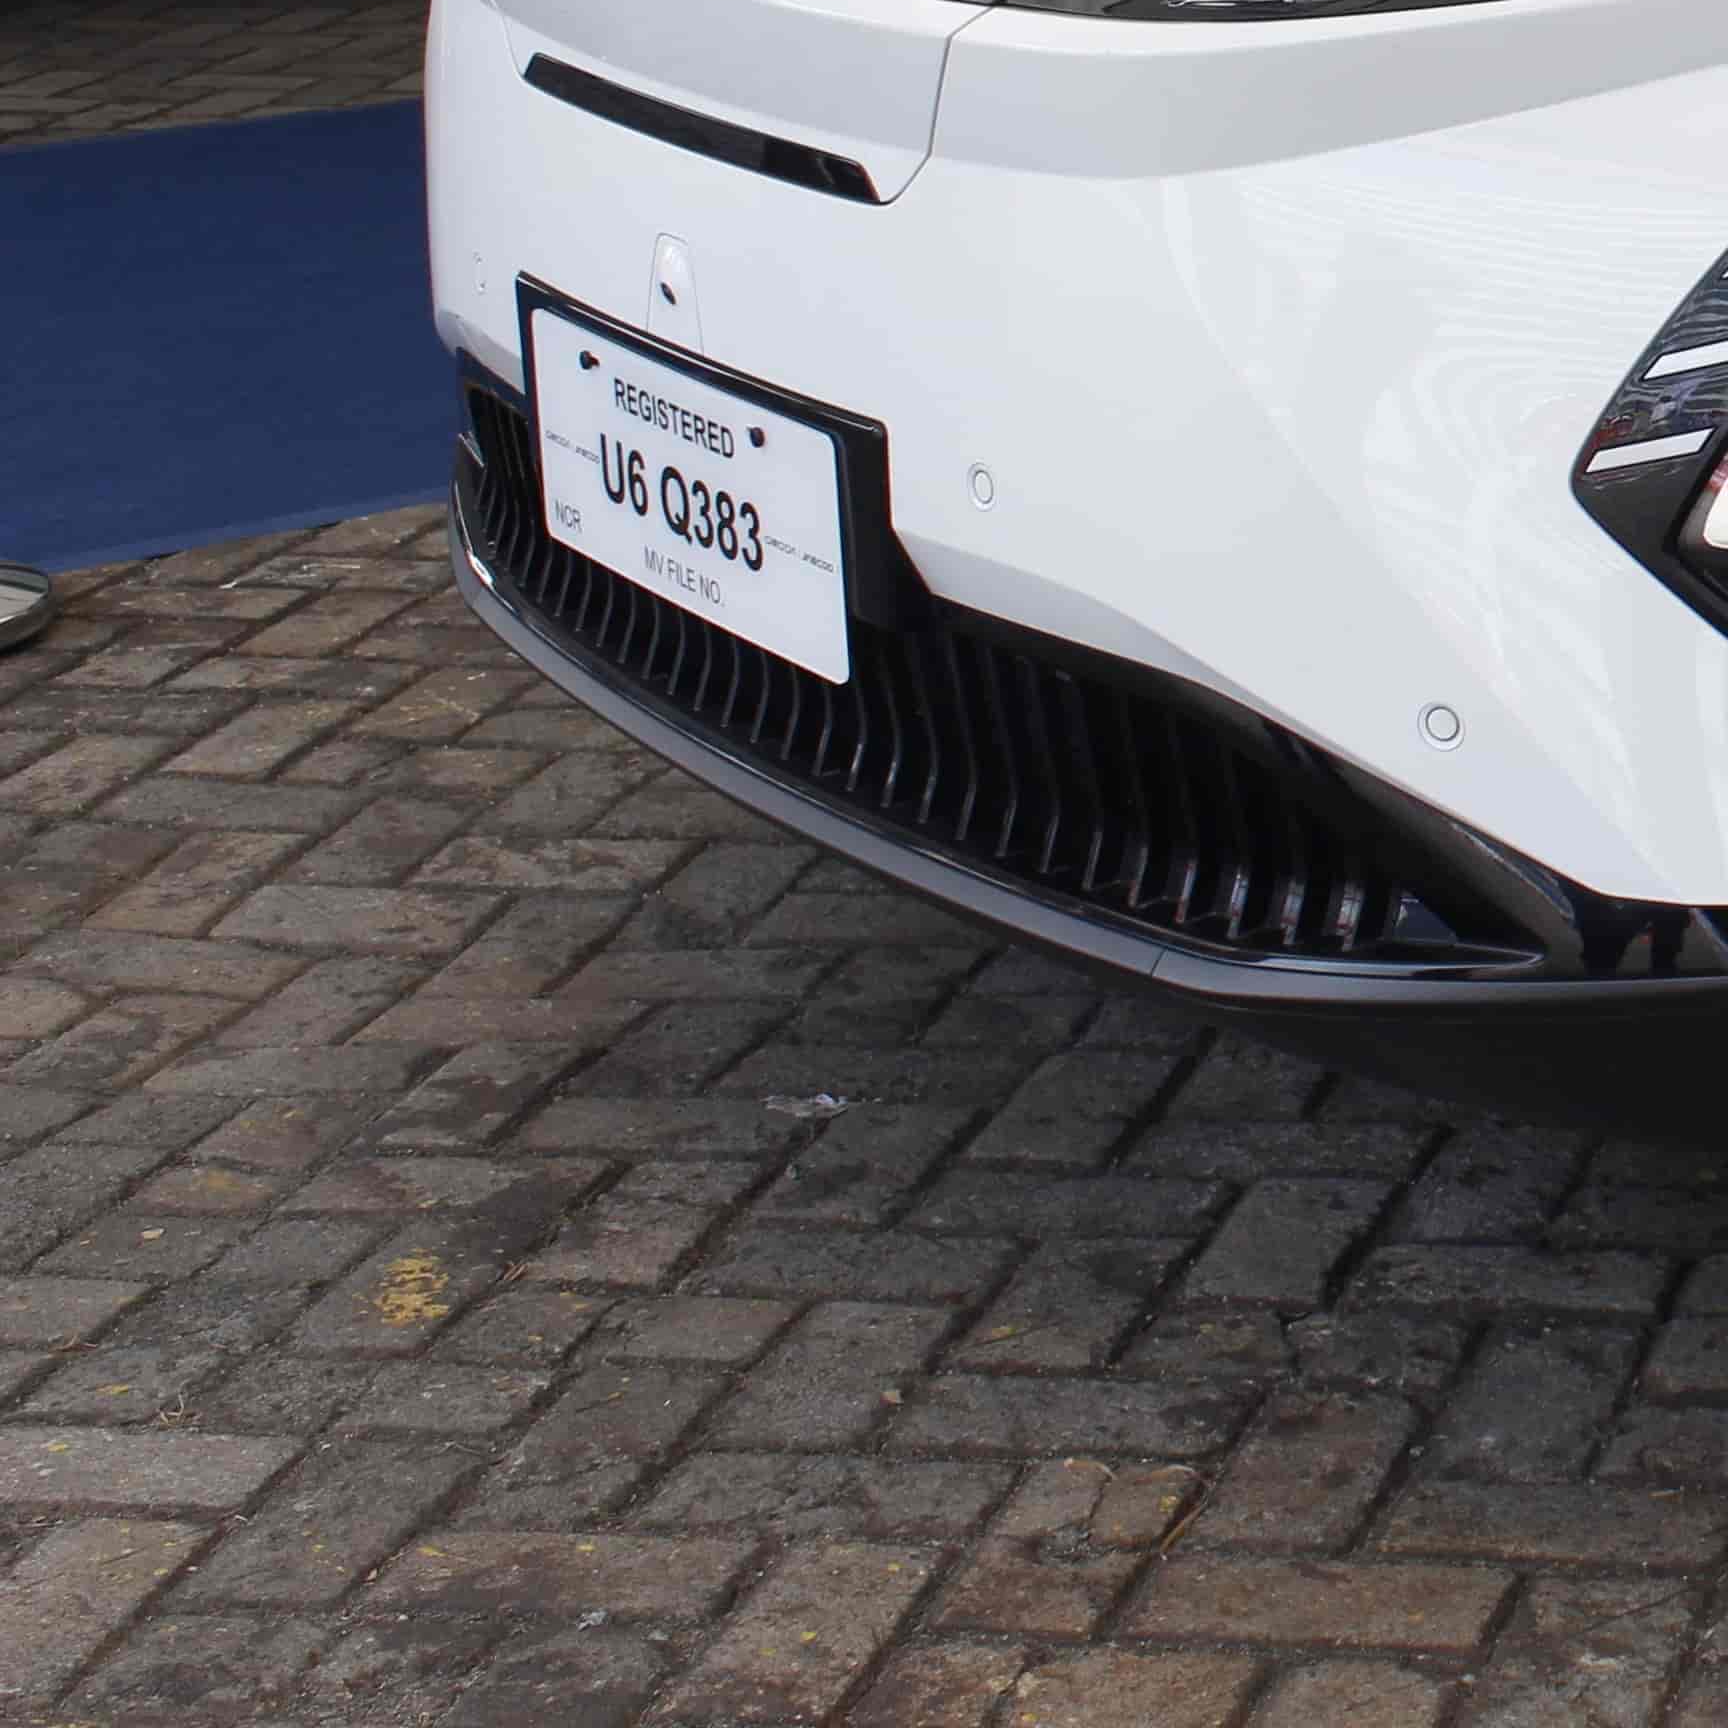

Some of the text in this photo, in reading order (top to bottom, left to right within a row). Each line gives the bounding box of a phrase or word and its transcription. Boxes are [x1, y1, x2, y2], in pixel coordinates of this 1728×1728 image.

[614, 377, 735, 459] REGISTERED
[554, 499, 582, 533] NCR
[601, 432, 764, 572] U6 Q383
[644, 545, 666, 577] MV
[667, 558, 696, 593] FILE
